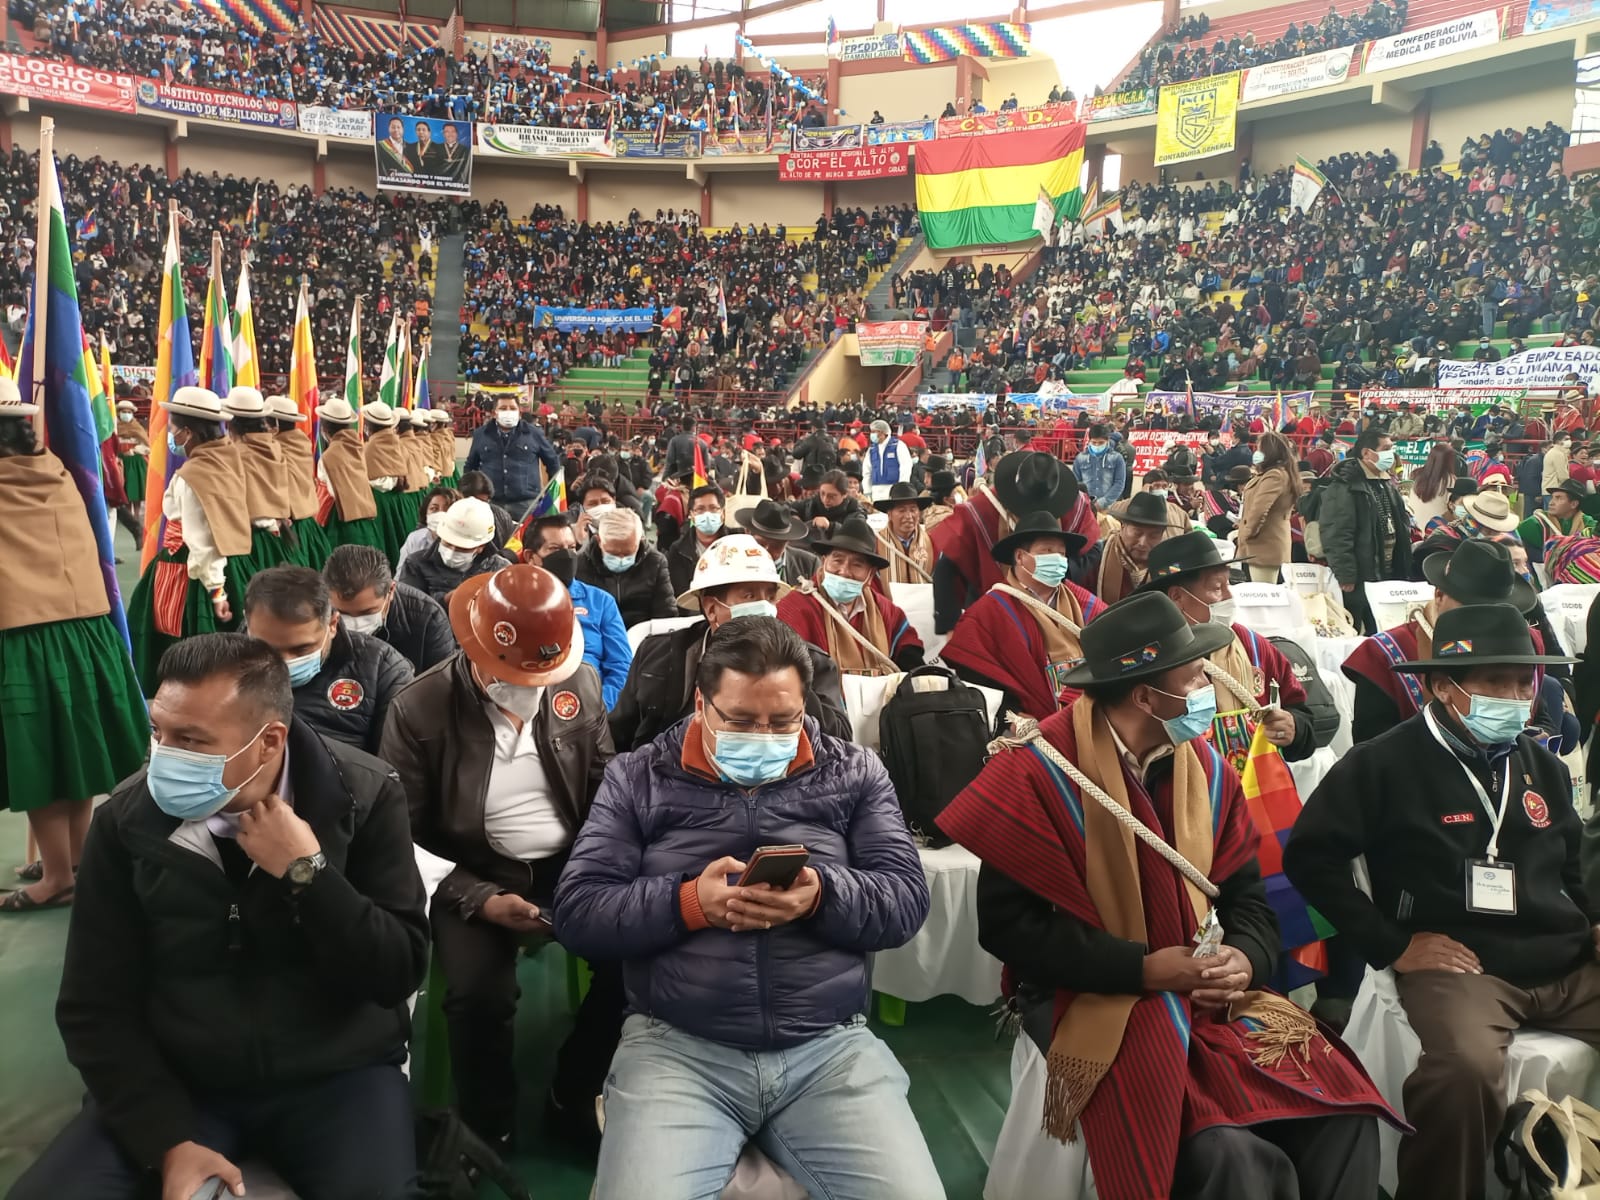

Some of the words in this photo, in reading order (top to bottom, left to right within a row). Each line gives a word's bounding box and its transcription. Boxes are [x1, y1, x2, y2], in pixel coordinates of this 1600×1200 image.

[1393, 20, 1473, 49] CONFEDERACIÓN
[844, 42, 885, 55] FREDDY
[1386, 46, 1421, 60] MEDICA
[1424, 42, 1437, 51] DE
[1439, 30, 1478, 48] BOLIVIA
[160, 85, 213, 102] INSTITUTO
[205, 105, 218, 116] DE
[556, 135, 590, 144] BOLIVIA
[790, 151, 814, 159] CENTRAL
[854, 154, 887, 167] ALTO
[1577, 362, 1600, 374] NA
[1250, 399, 1276, 407] ESCOLA
[1480, 397, 1497, 405] PAZ
[1406, 441, 1419, 454] EL
